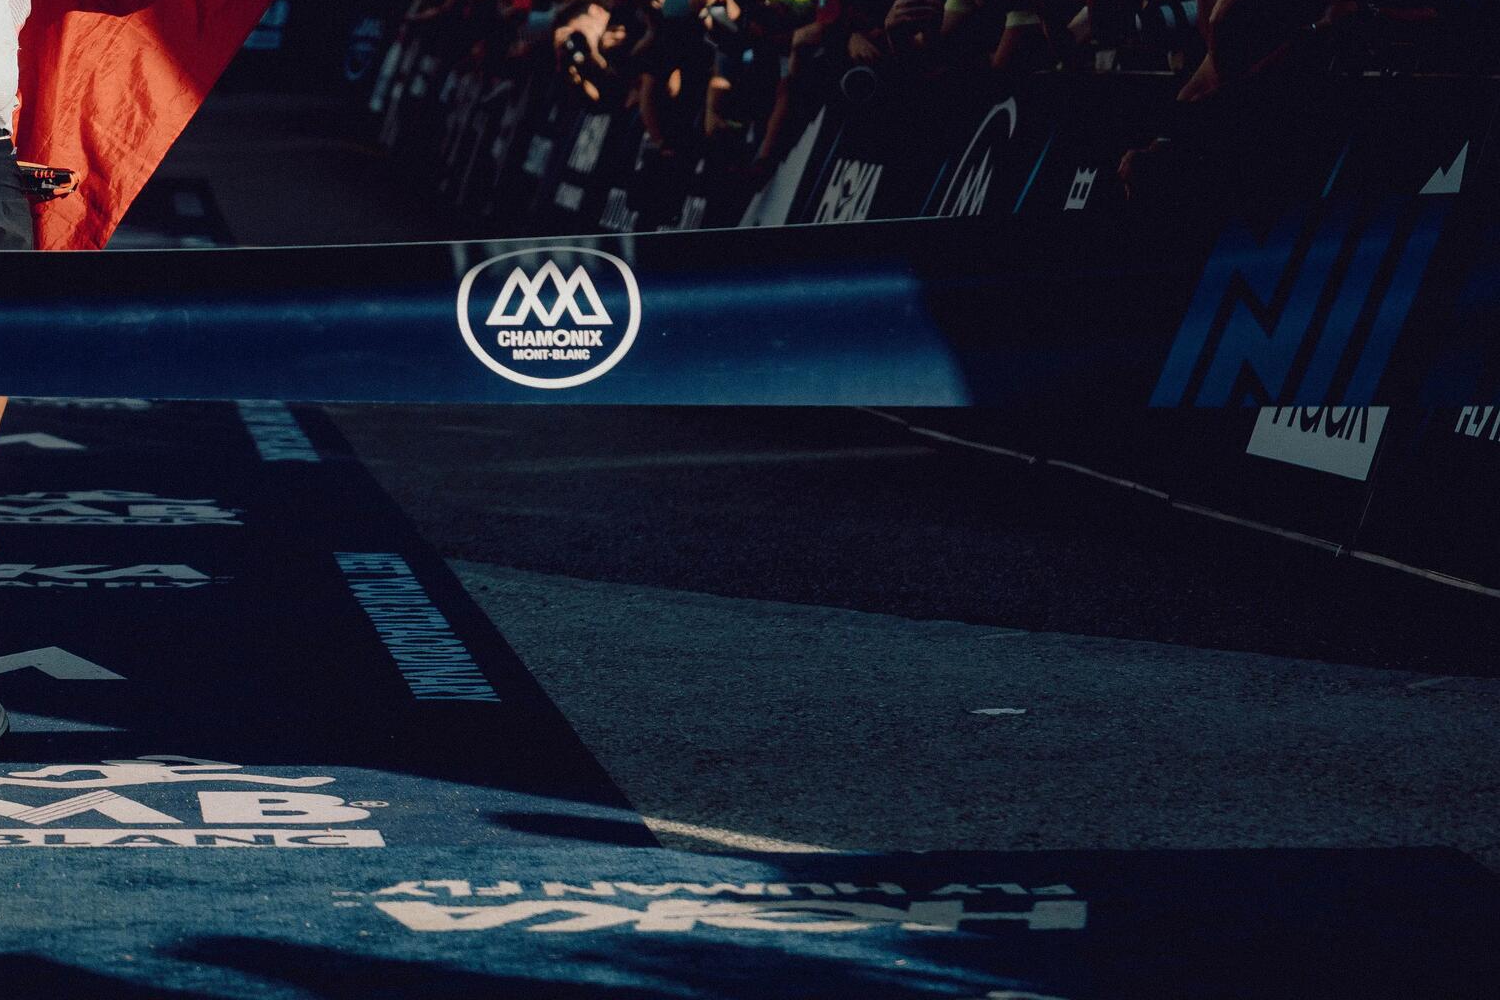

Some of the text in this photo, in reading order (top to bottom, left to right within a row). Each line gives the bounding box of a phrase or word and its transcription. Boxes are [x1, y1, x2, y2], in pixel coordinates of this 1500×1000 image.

[497, 329, 603, 347] CHAMONIX
[348, 577, 433, 604] YOUR
[365, 606, 499, 701] EXTRAORDINARY
[373, 899, 1087, 933] HOKA
